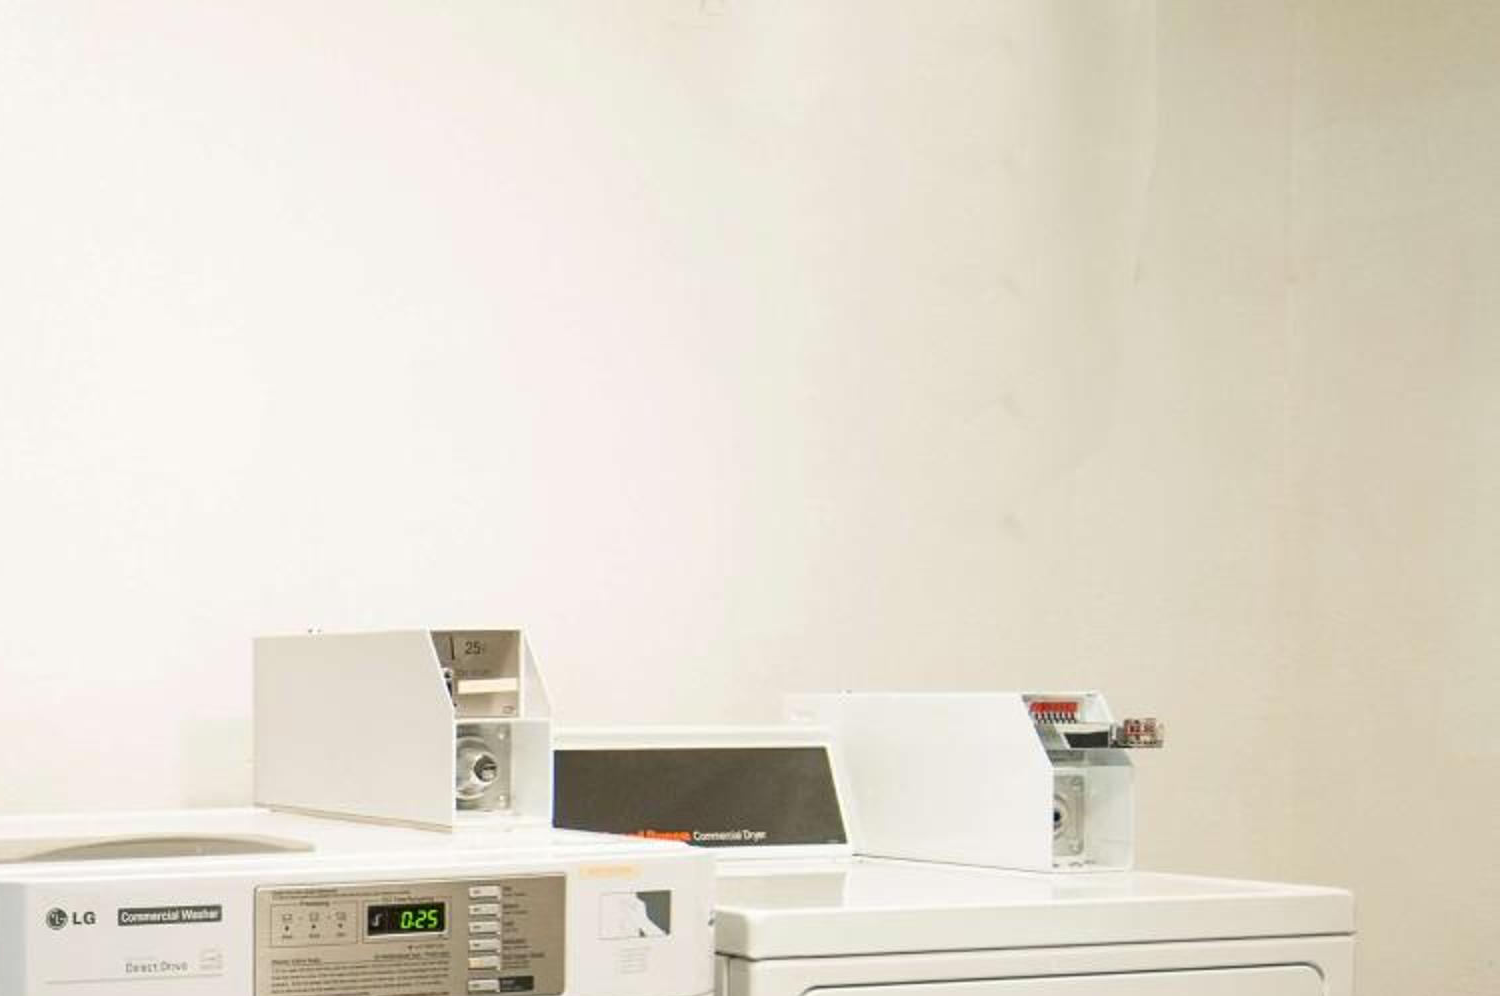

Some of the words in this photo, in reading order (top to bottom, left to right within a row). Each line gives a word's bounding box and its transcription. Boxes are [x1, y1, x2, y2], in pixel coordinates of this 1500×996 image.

[693, 830, 743, 841] Commercial
[743, 829, 768, 843] Dryer
[72, 911, 97, 925] LG
[121, 910, 180, 923] Commercial
